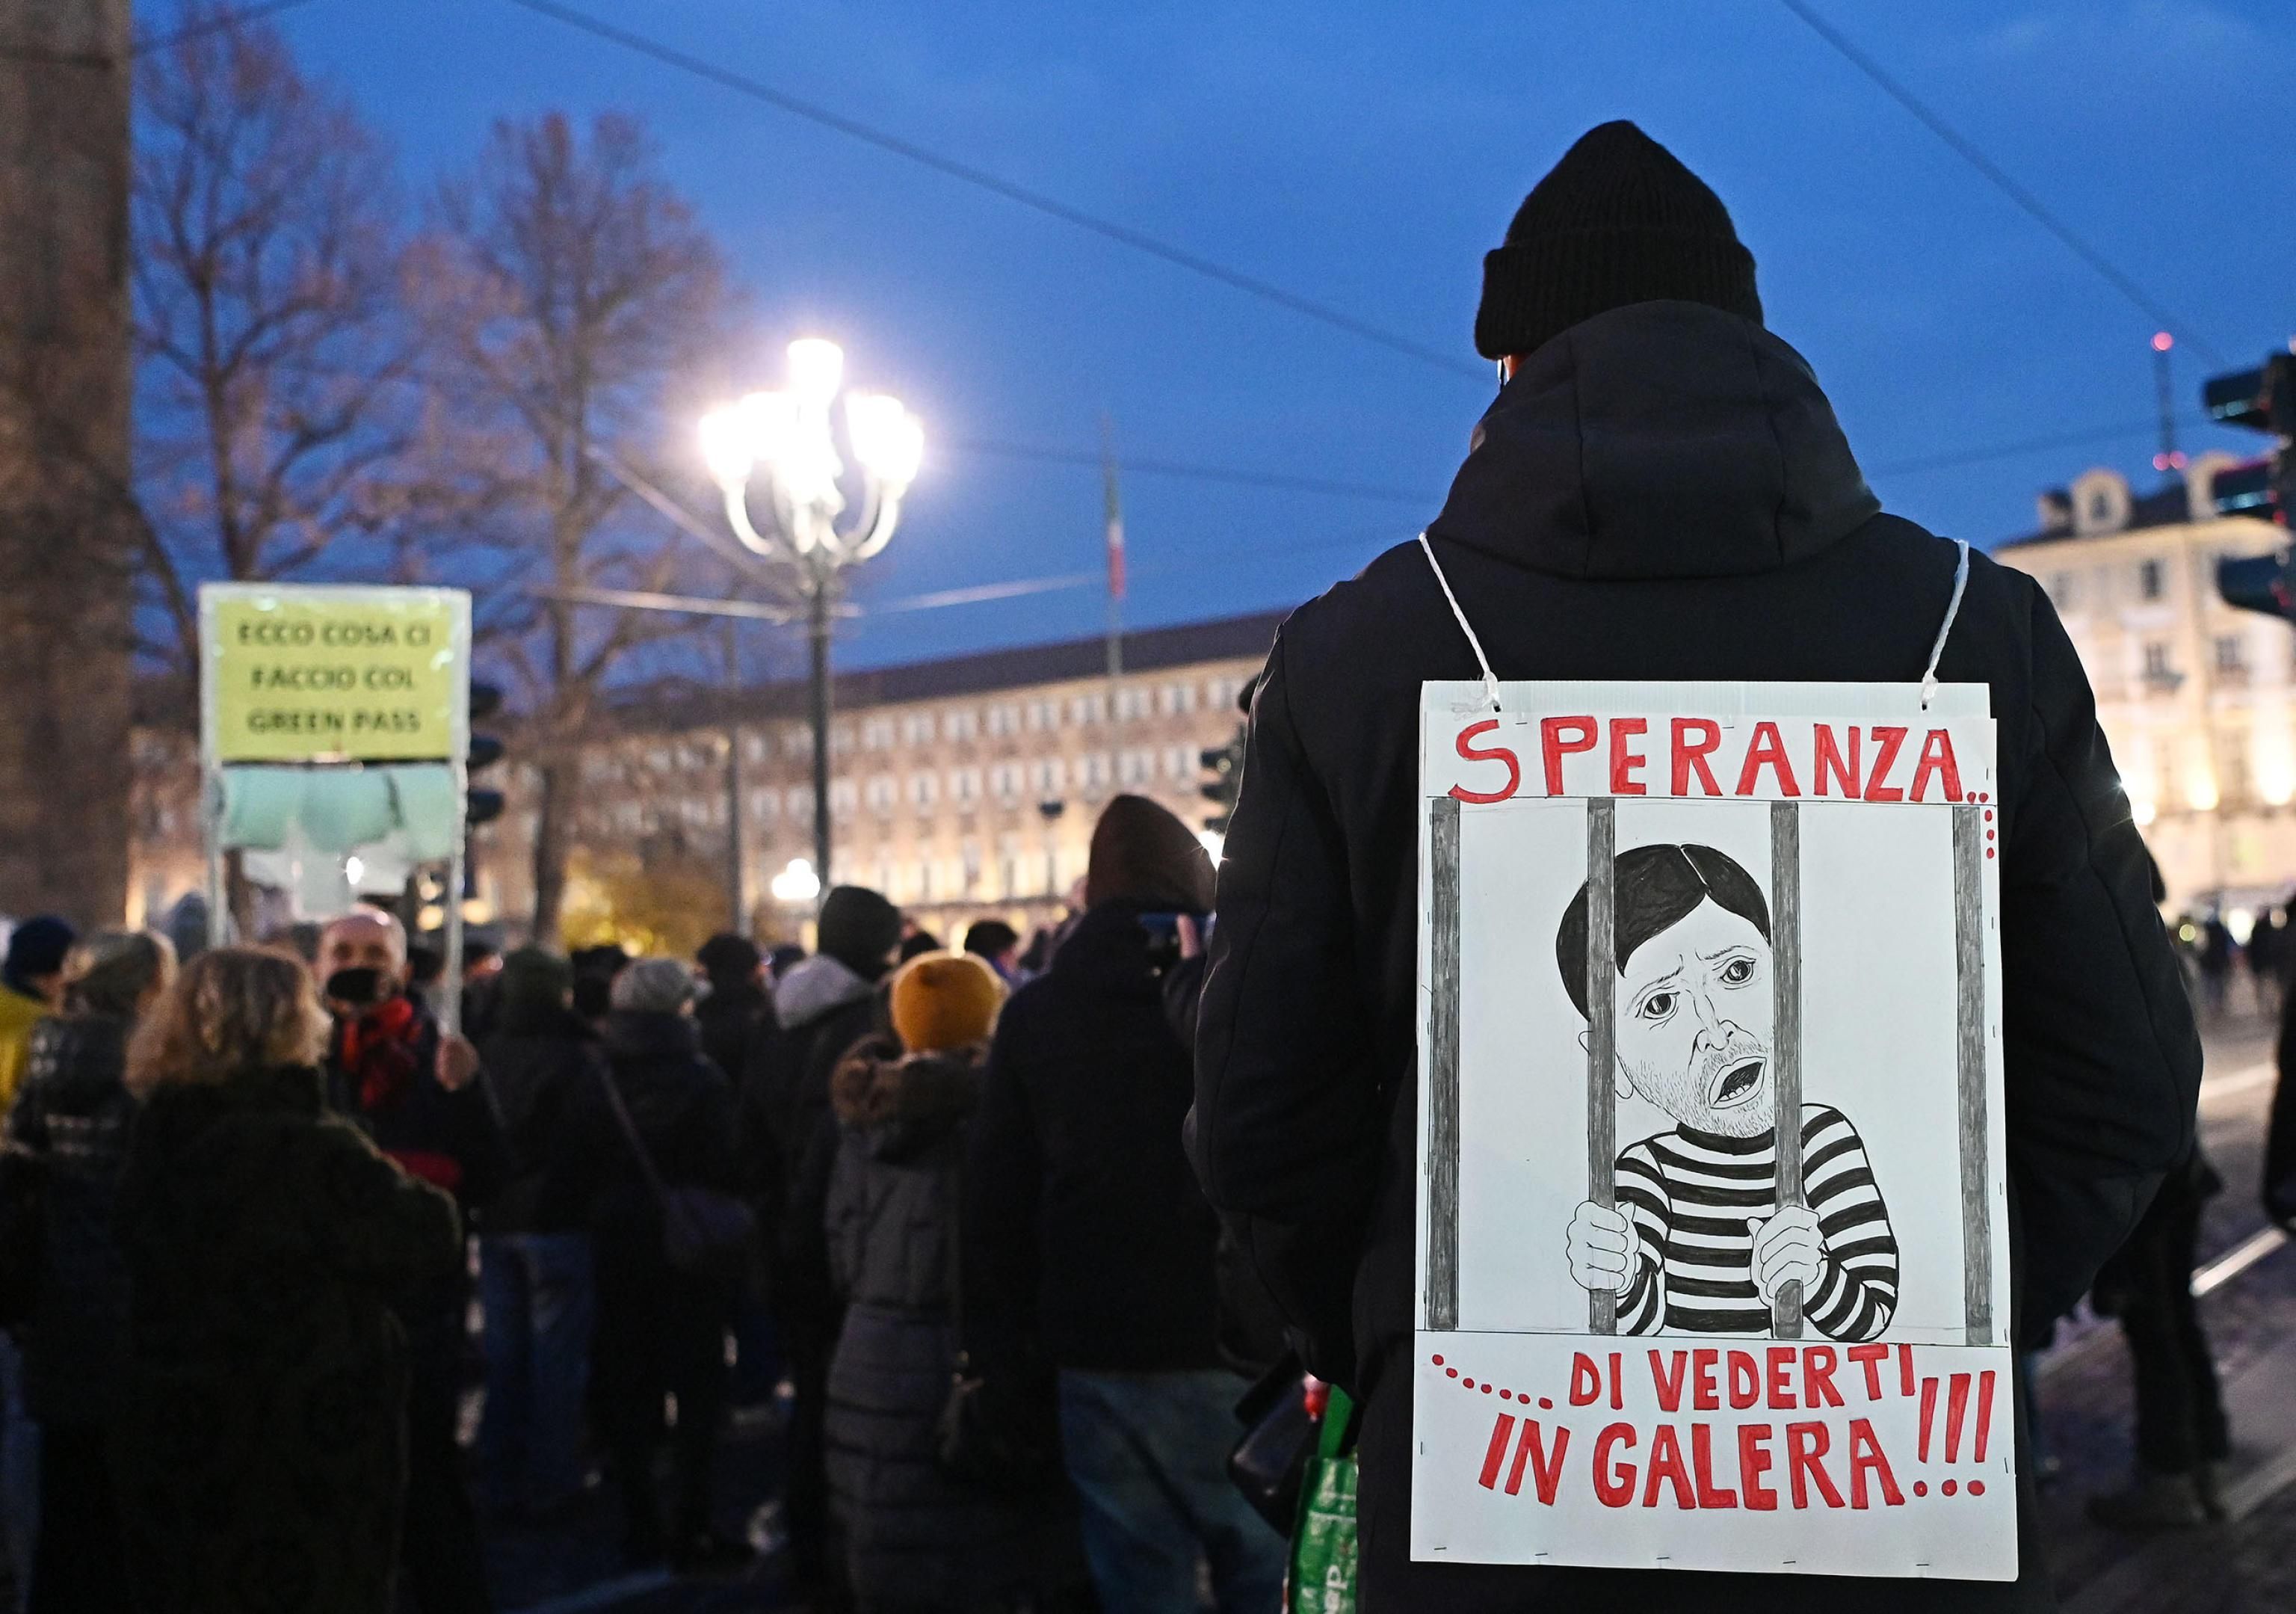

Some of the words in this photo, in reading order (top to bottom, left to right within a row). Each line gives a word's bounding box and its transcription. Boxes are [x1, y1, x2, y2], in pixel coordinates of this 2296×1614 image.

[238, 620, 314, 647] ECCO
[321, 621, 397, 647] COSA
[404, 622, 431, 647] CI
[251, 666, 357, 692] FACCIO
[364, 666, 414, 691] COL
[247, 709, 345, 735] GREEN
[352, 709, 422, 734] PASS
[1649, 1343, 1916, 1412] VEDERTI
[1479, 1413, 1570, 1506] IN
